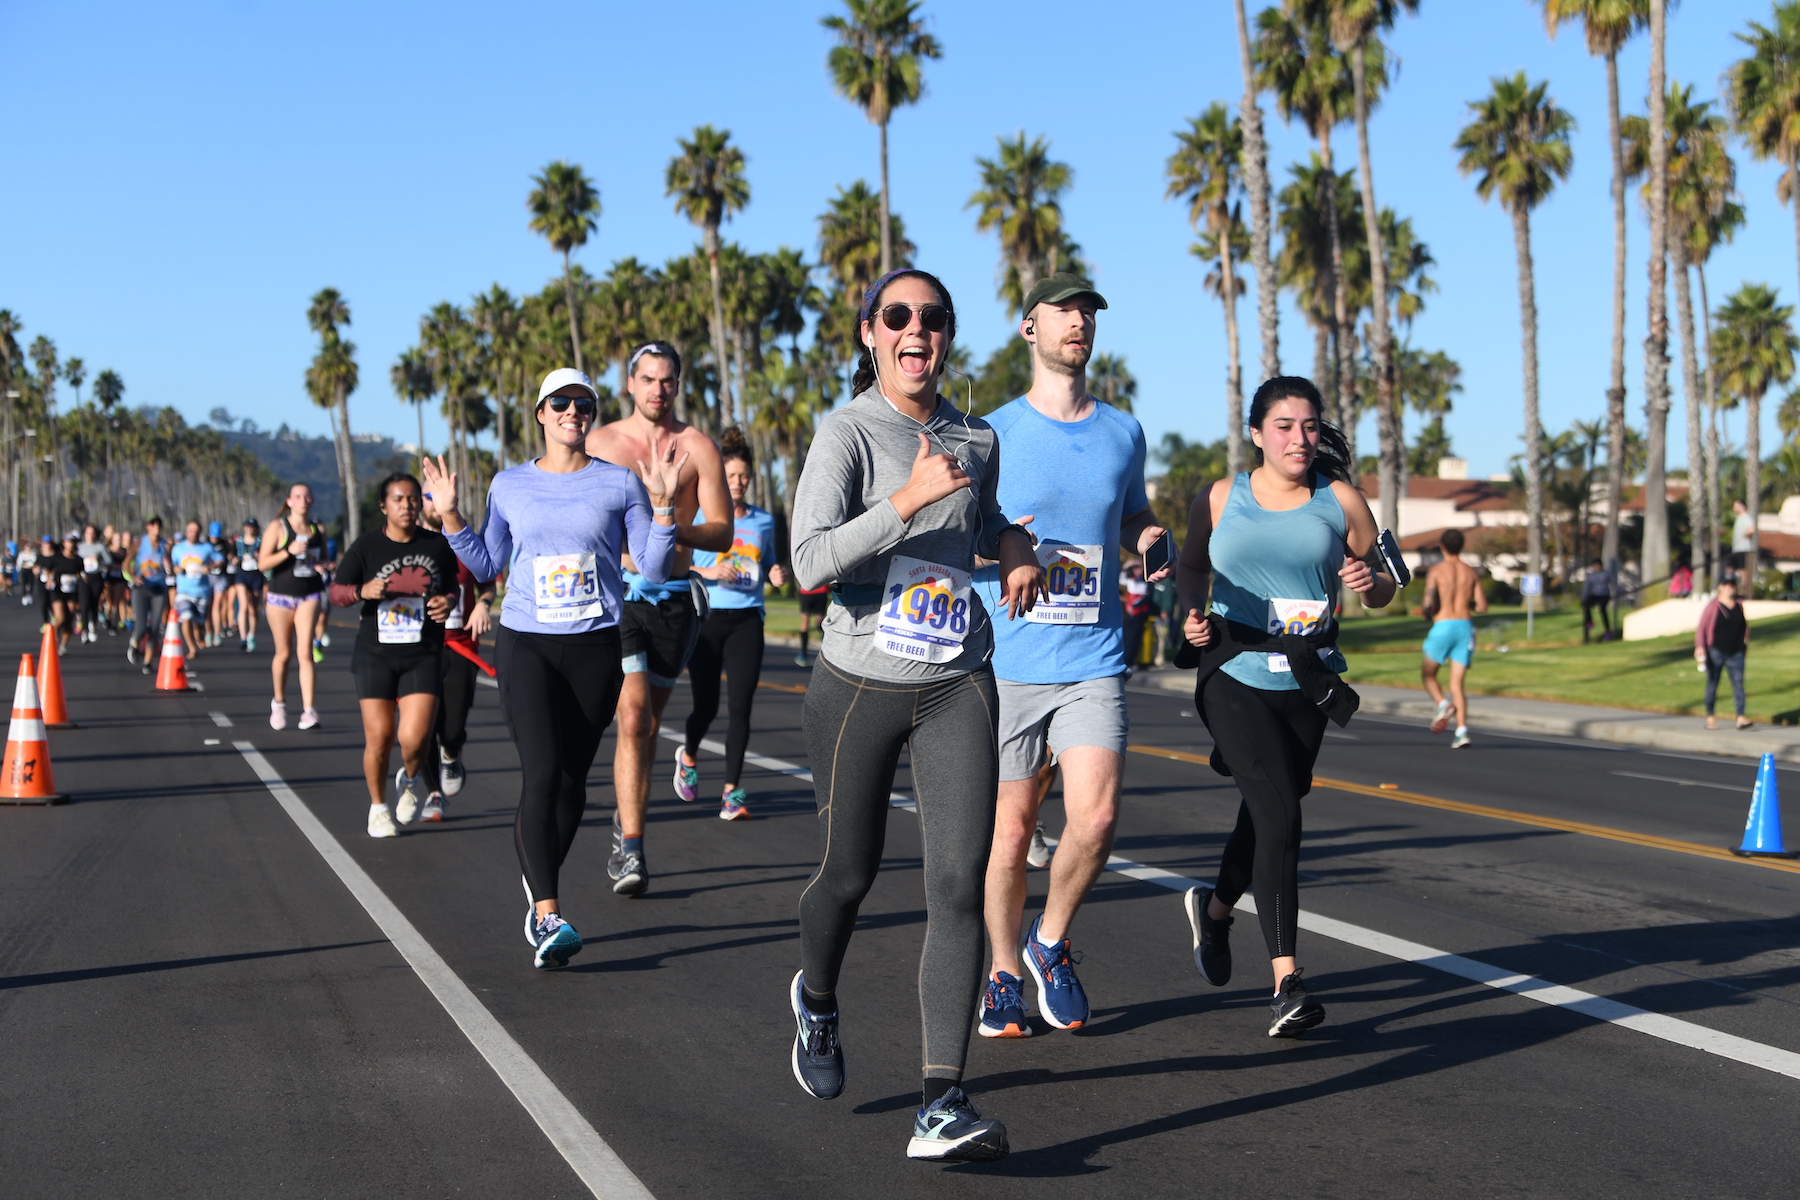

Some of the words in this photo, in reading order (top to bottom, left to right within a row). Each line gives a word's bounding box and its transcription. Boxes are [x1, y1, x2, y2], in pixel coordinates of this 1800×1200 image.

[373, 558, 401, 580] HOT
[908, 566, 926, 578] SANTA
[928, 565, 951, 578] BARBARA
[884, 583, 967, 634] 1998
[1036, 611, 1051, 620] FREE
[1052, 611, 1068, 620] BEER
[886, 640, 905, 653] FREE
[905, 644, 926, 657] BEER
